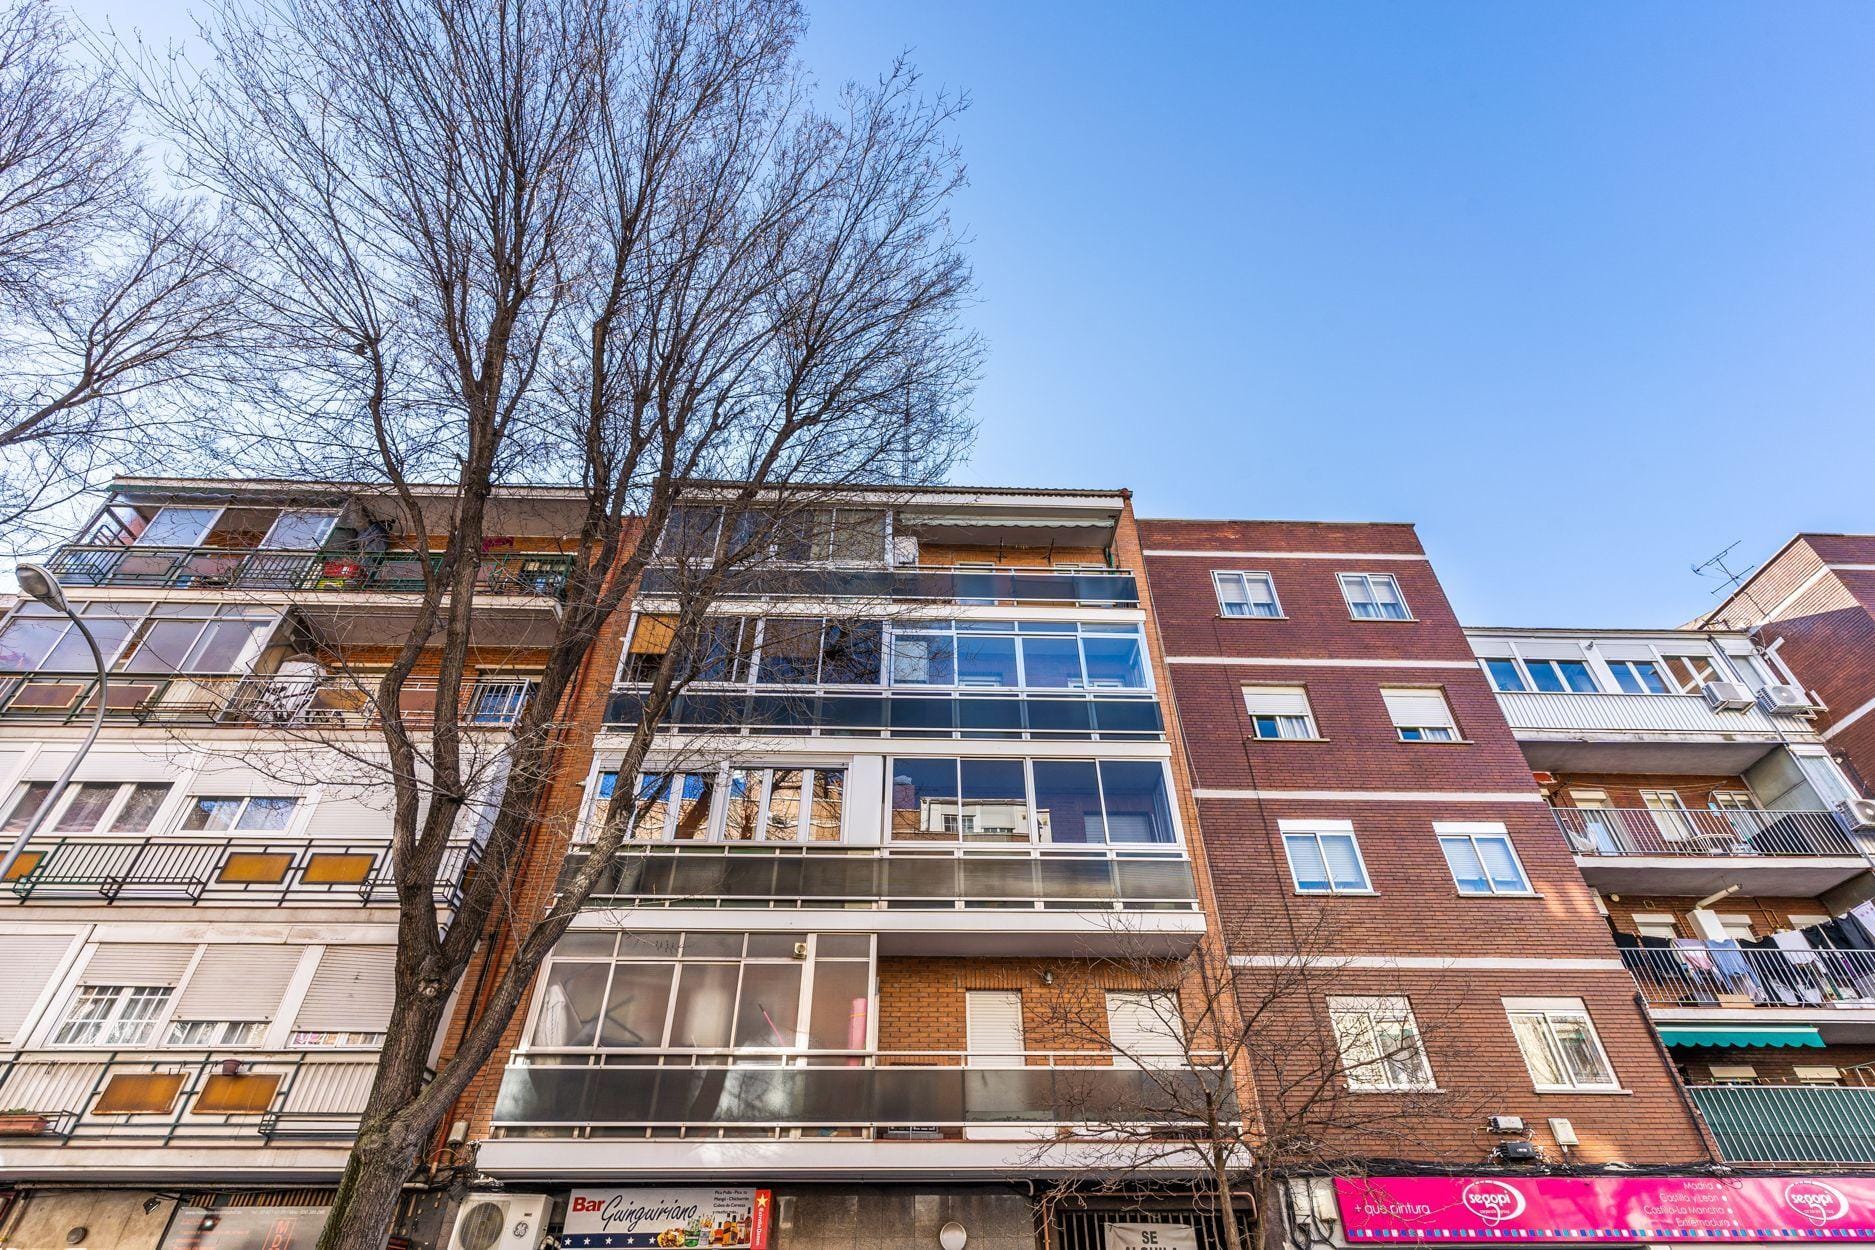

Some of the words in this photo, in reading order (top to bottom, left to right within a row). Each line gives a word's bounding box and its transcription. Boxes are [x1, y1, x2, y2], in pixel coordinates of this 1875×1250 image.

[572, 1197, 605, 1212] Bar
[1469, 1190, 1511, 1208] segopi
[1791, 1190, 1834, 1208] segopi
[1141, 1230, 1158, 1245] SE
